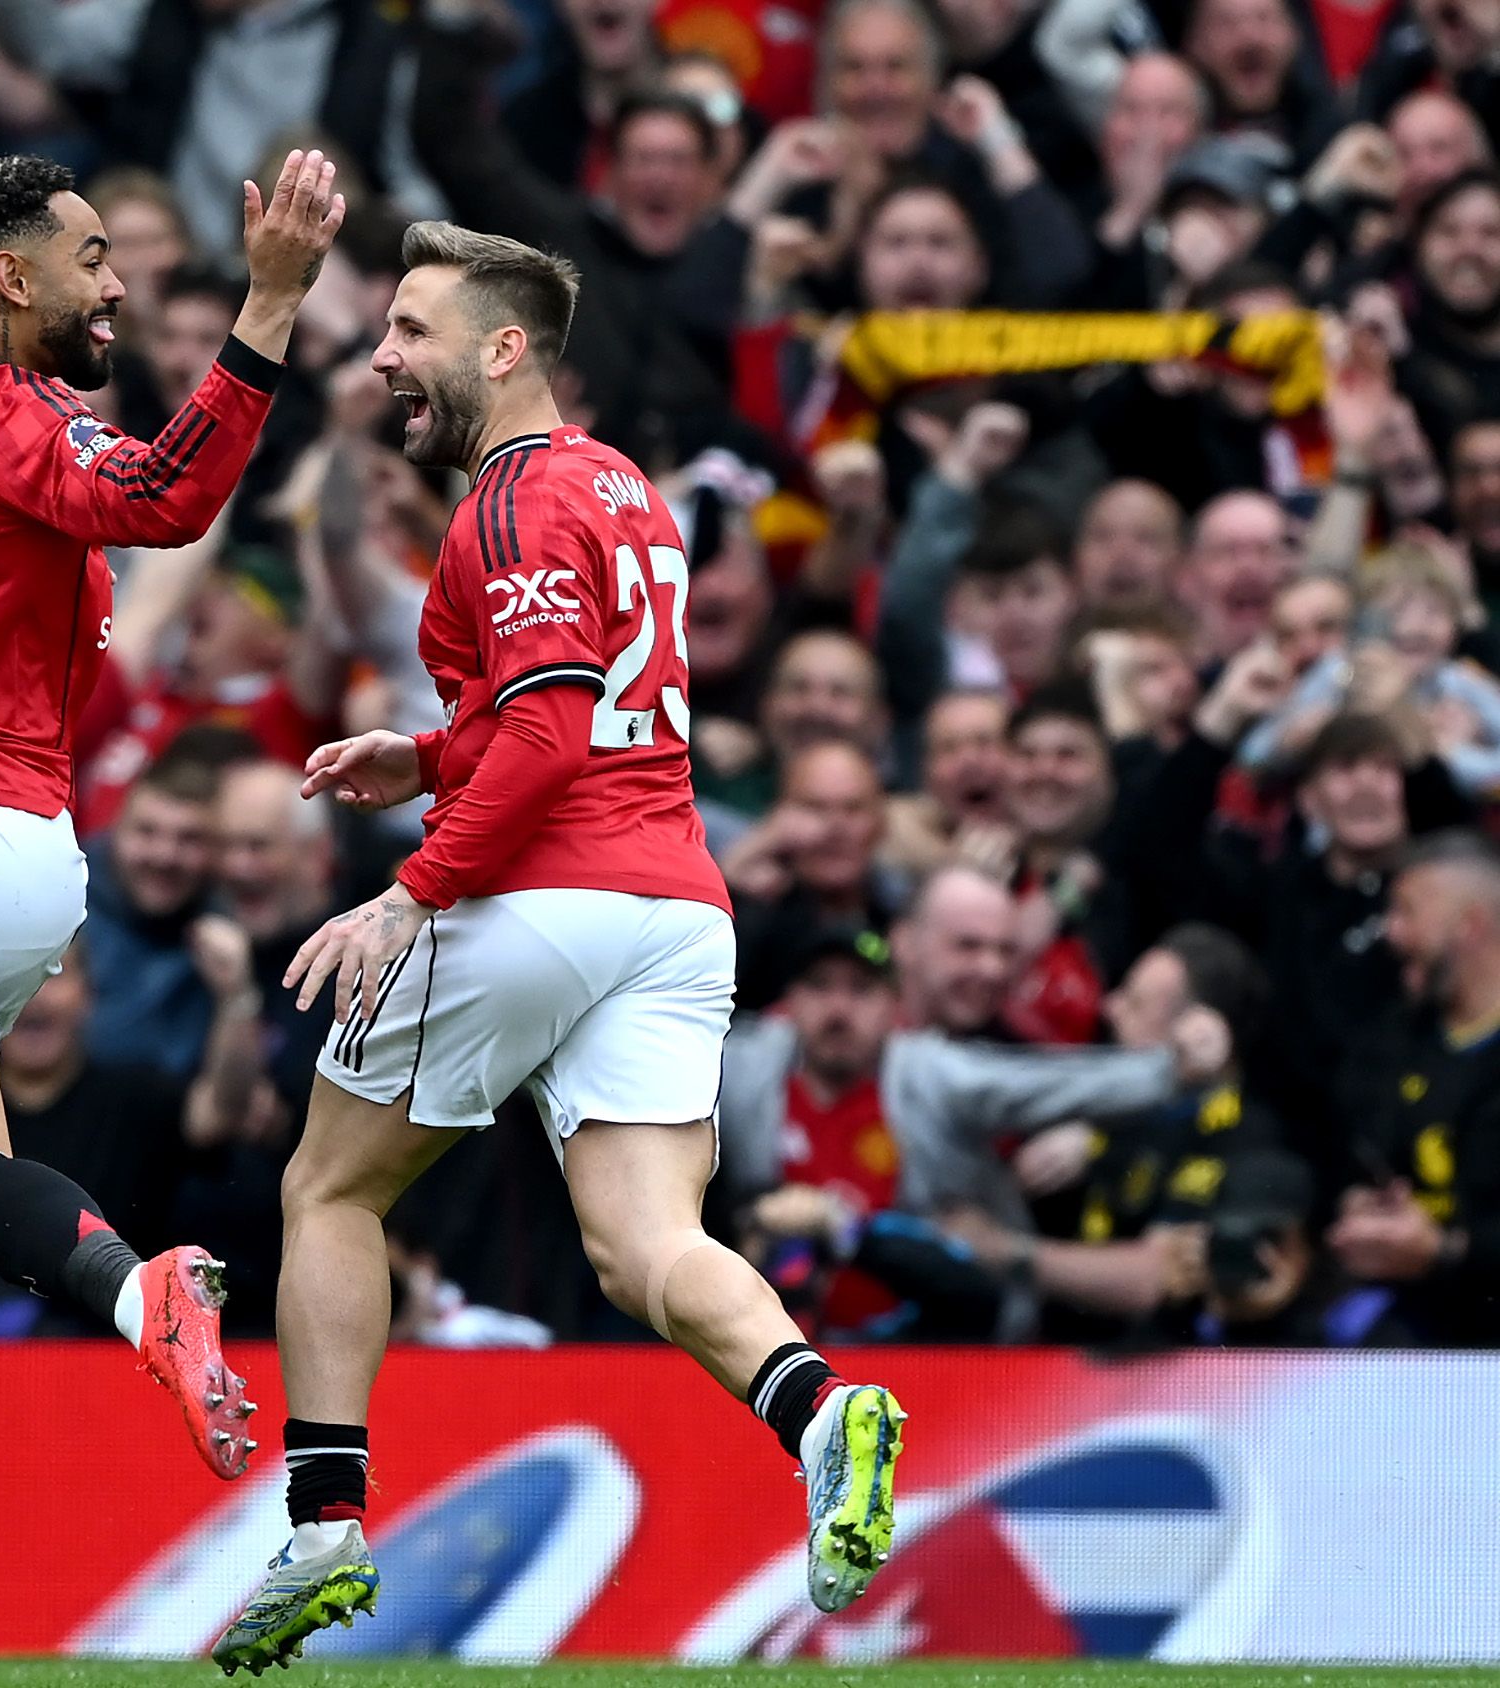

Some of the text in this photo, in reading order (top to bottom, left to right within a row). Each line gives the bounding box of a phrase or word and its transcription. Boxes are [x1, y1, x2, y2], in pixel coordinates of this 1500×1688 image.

[592, 469, 651, 516] SHAW
[484, 568, 581, 625] DXC
[494, 611, 581, 639] TECHNOLOGY
